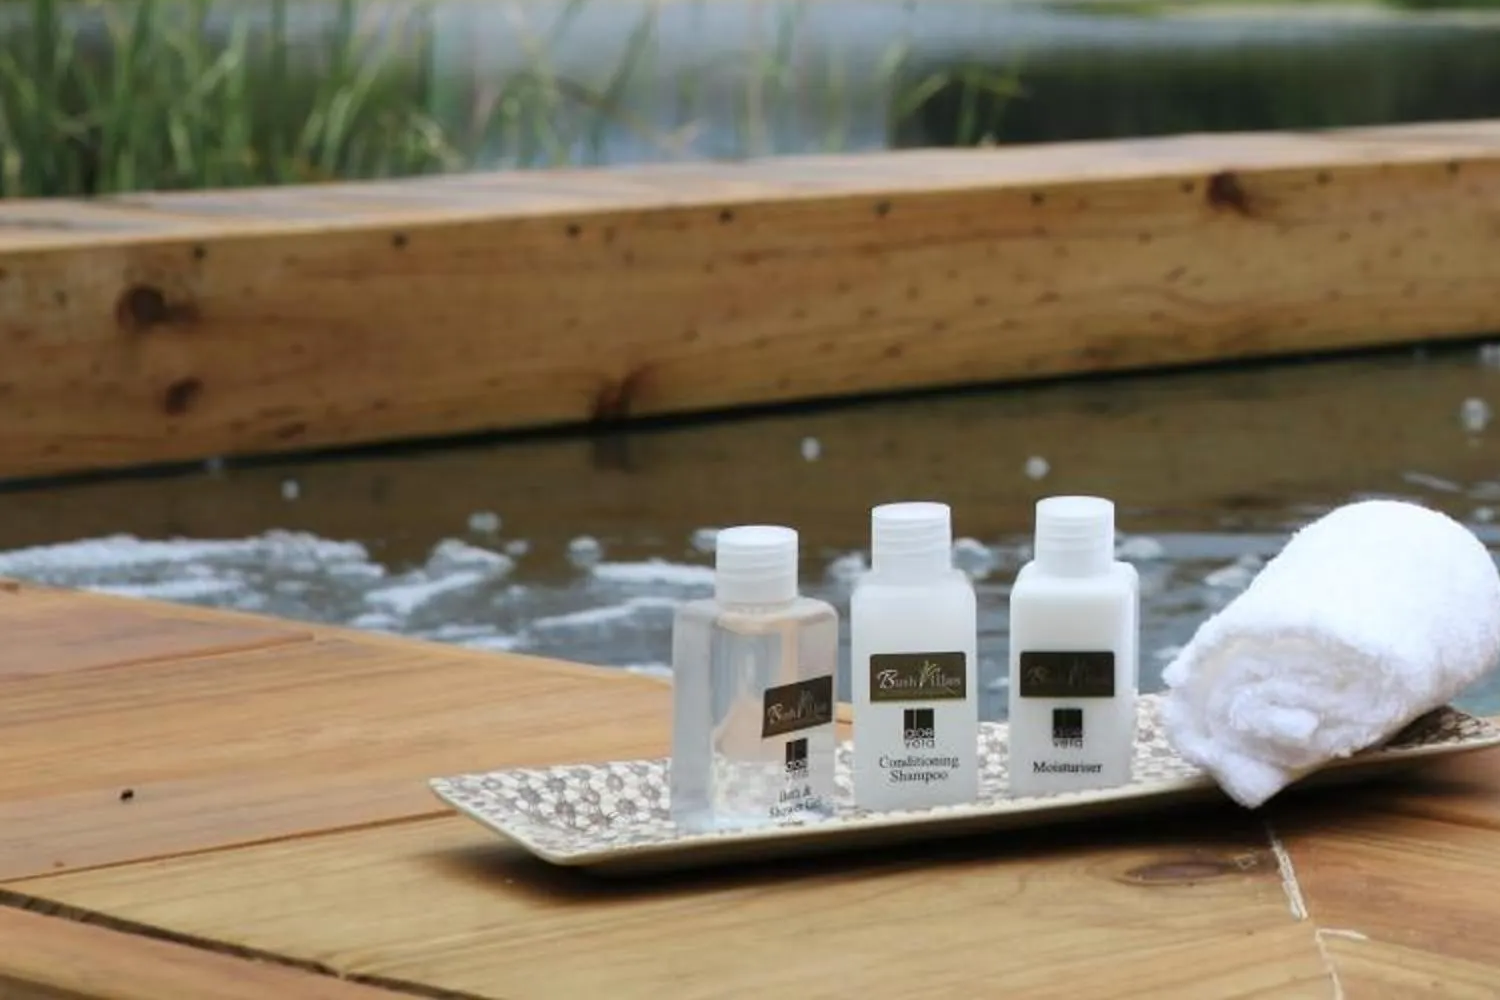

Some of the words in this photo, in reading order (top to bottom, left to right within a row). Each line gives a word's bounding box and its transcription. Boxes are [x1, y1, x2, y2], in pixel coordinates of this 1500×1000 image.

[879, 755, 960, 769] Conditioning
[1032, 760, 1104, 775] Moisturiser
[889, 769, 949, 785] Shampoo
